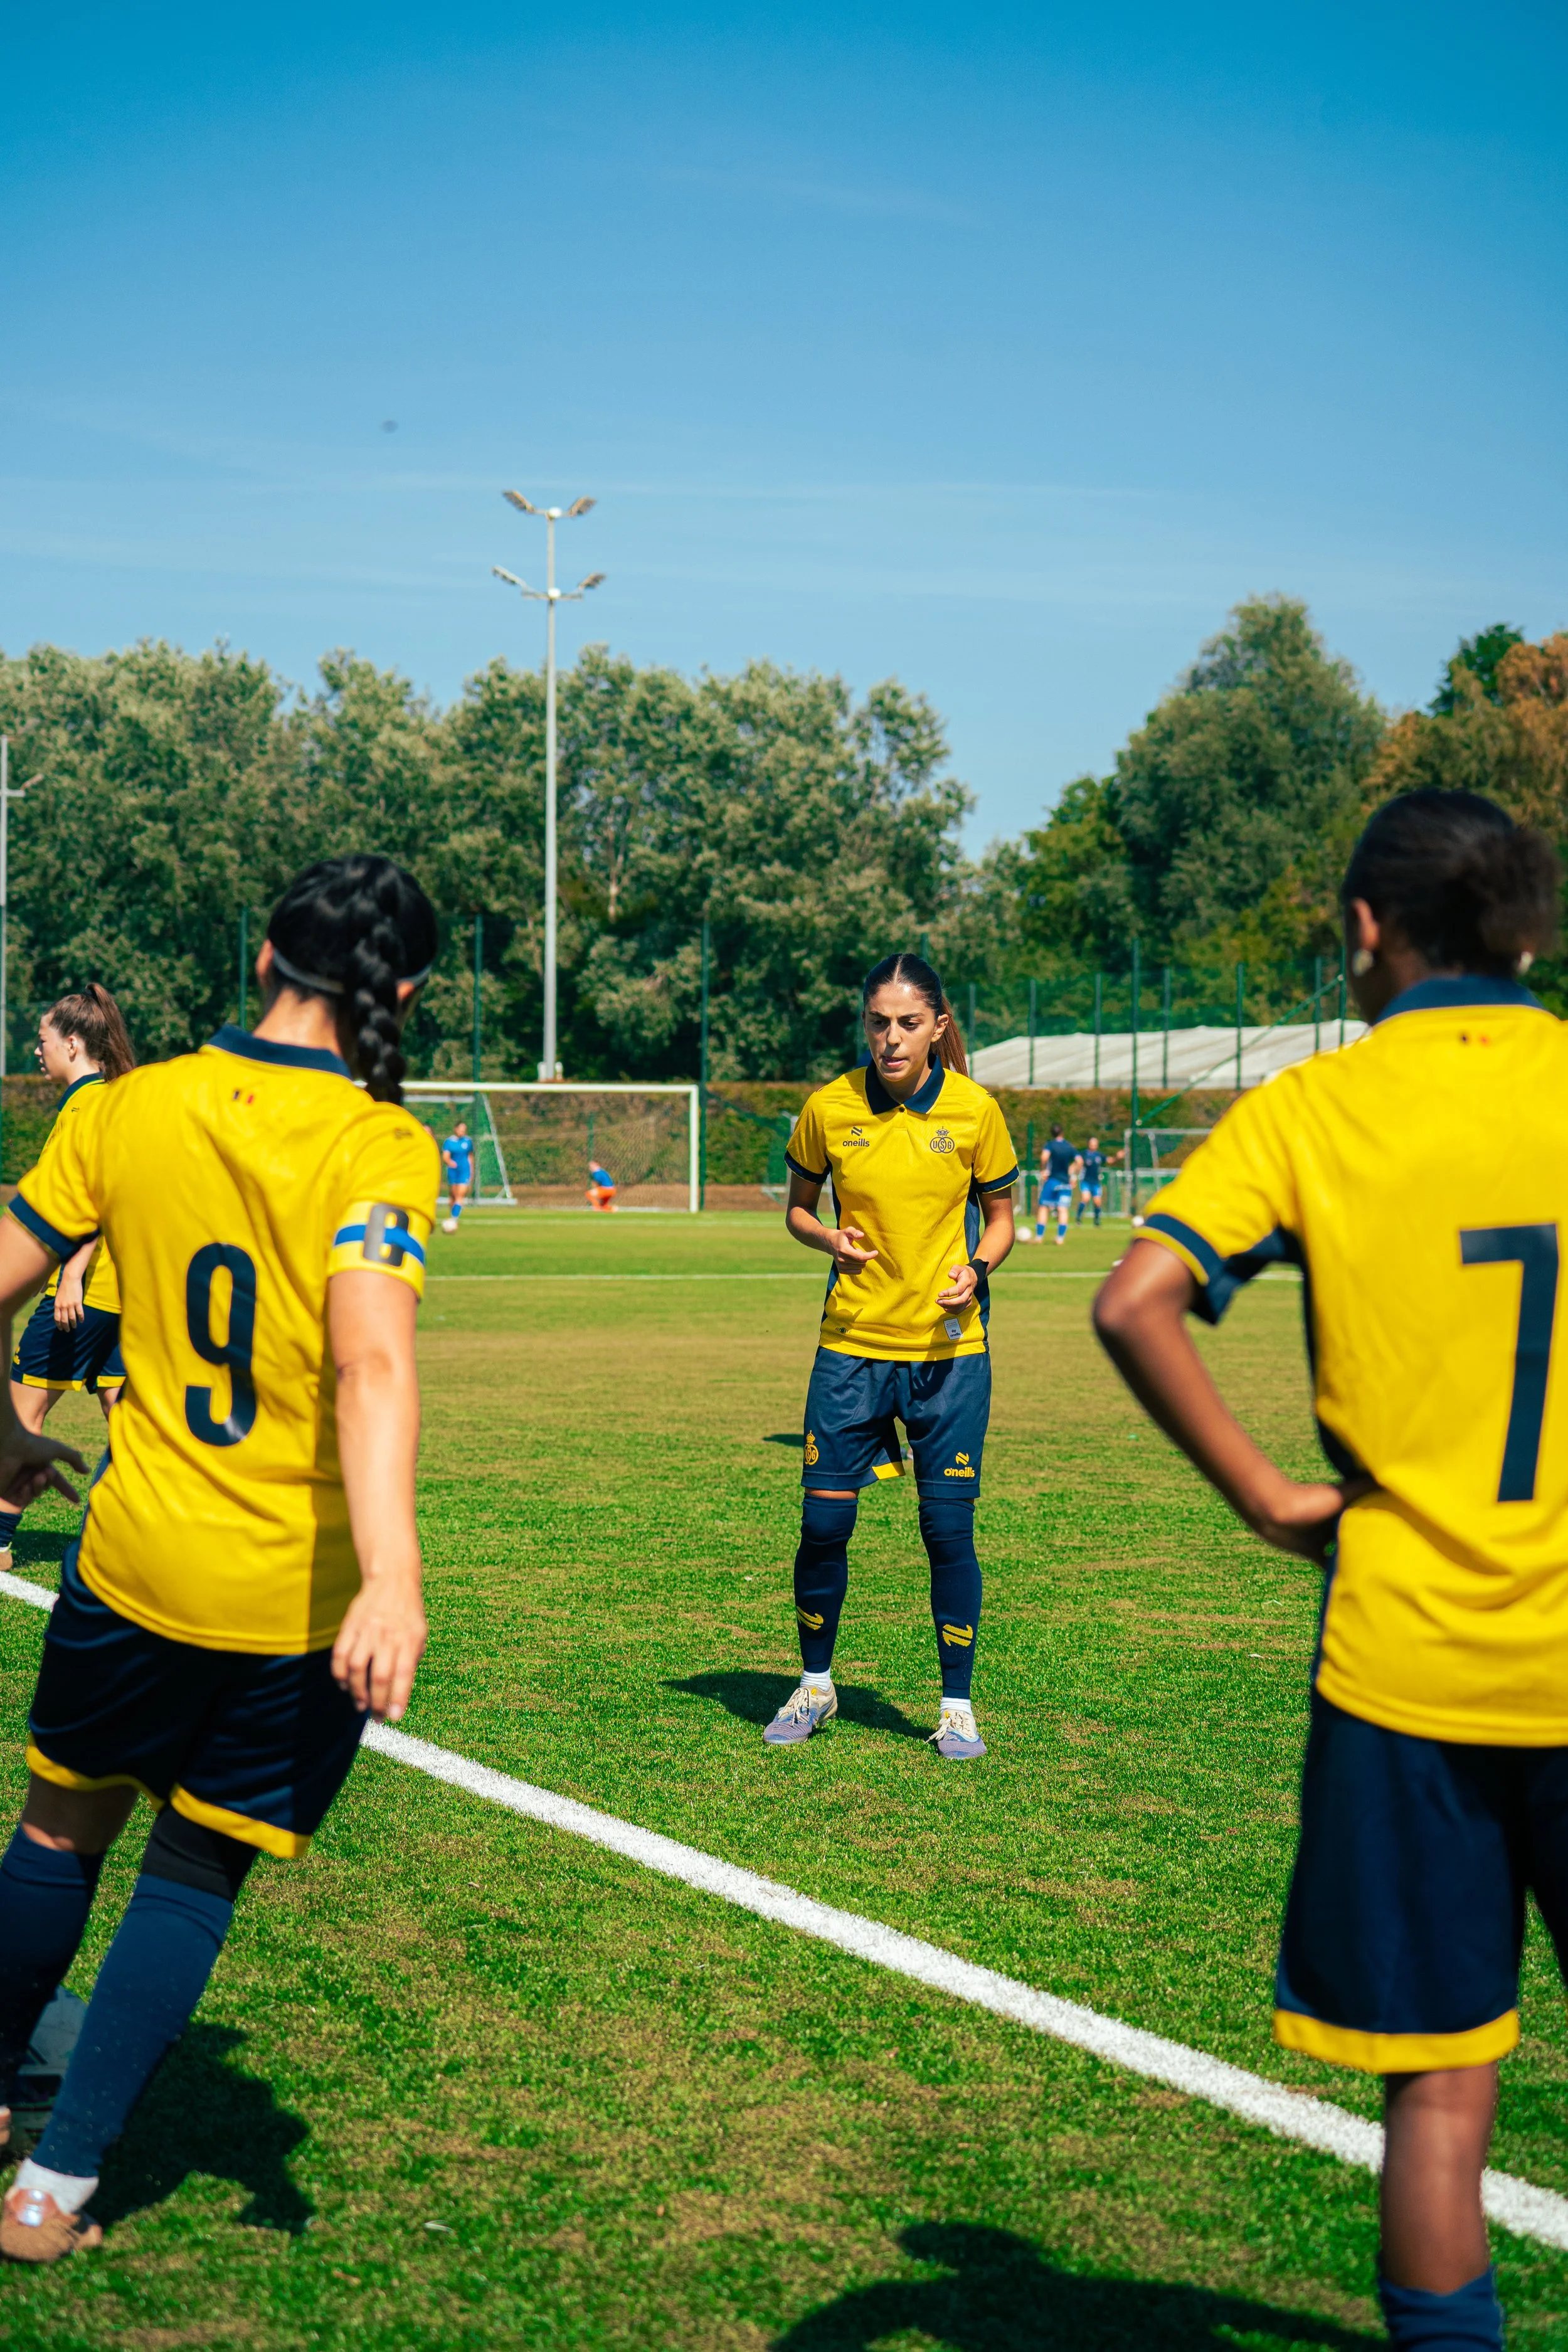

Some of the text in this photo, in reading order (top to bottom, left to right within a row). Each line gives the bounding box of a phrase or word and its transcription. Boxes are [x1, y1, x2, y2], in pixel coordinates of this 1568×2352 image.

[933, 1140, 951, 1149] USG
[185, 1242, 257, 1446] 9
[1459, 1224, 1559, 1503] 7
